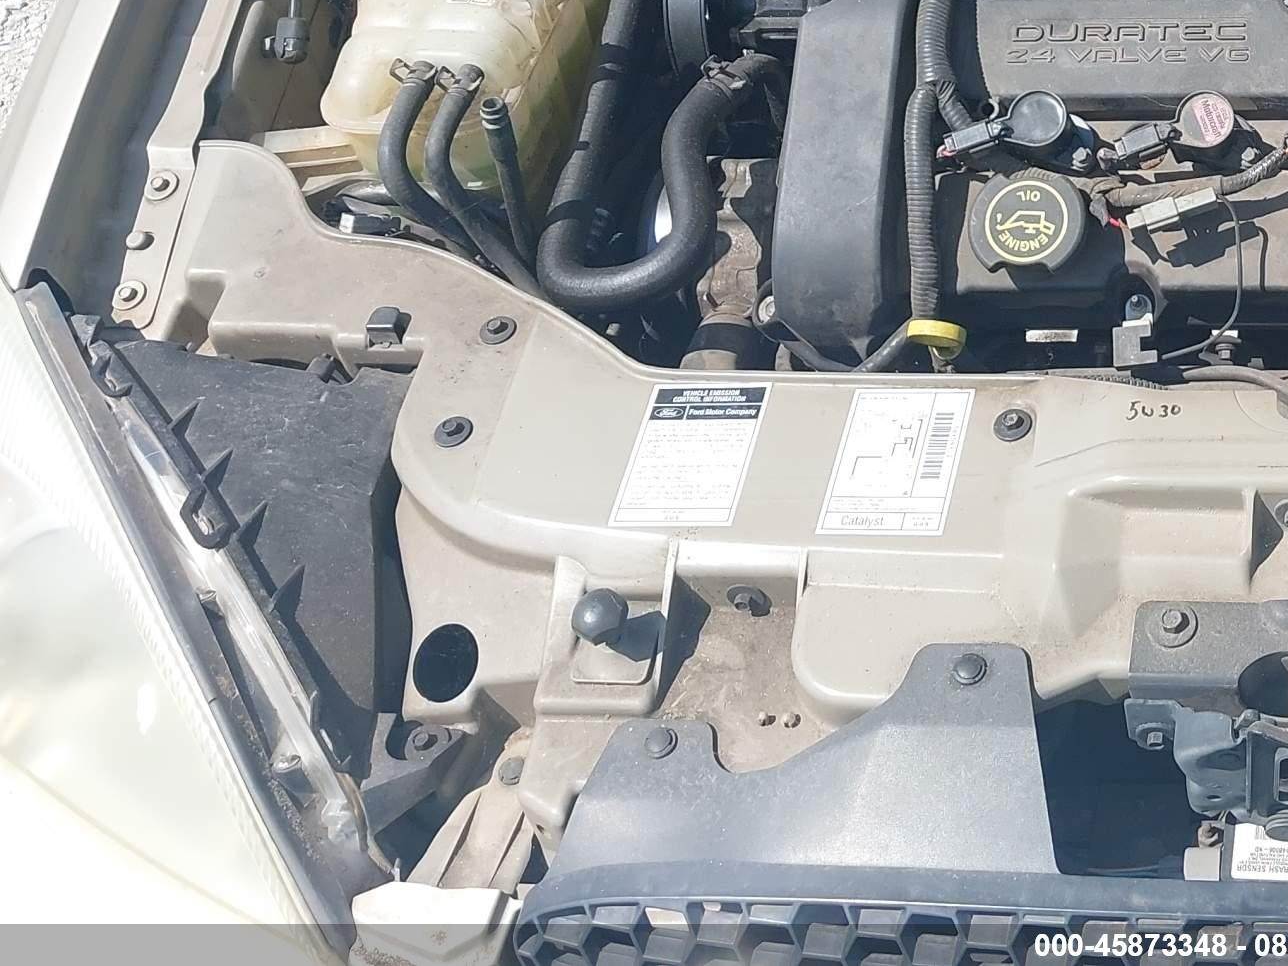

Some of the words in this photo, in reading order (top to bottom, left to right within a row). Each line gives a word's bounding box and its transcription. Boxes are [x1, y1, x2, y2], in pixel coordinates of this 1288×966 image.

[1012, 21, 1248, 44] DURATEC
[1006, 47, 1056, 64] 24
[1067, 47, 1188, 64] VALVE
[1200, 47, 1251, 64] V6
[1200, 98, 1221, 139] Motorcraft
[1016, 190, 1041, 202] OIL
[998, 230, 1049, 252] ENGINE
[702, 395, 747, 403] INFORMATION
[688, 408, 705, 416] Ford
[705, 408, 725, 416] Motor
[725, 408, 758, 417] Company
[840, 515, 885, 529] Catalyst
[1236, 865, 1267, 873] SENSOR
